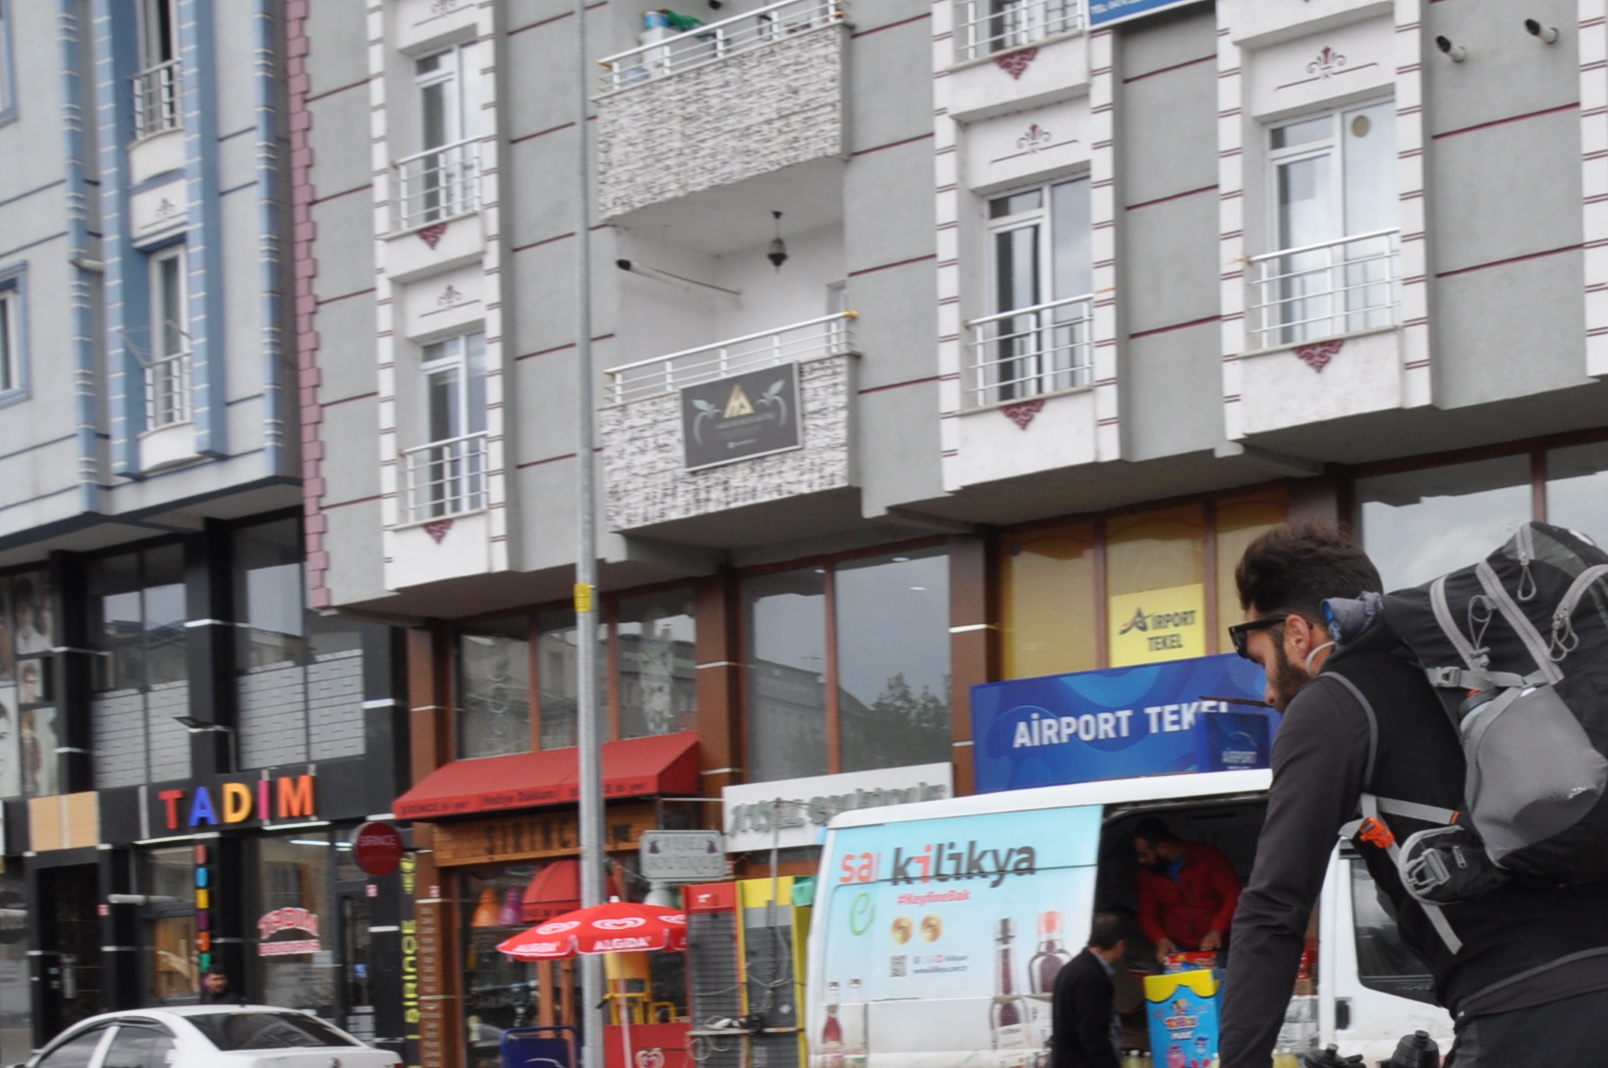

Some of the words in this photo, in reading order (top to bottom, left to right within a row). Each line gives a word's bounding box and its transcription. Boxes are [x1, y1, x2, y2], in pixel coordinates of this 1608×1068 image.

[1147, 633, 1184, 652] TEKEL
[1012, 709, 1133, 748] AİRPORT
[158, 774, 315, 830] TADIM
[892, 839, 1037, 888] kilikya
